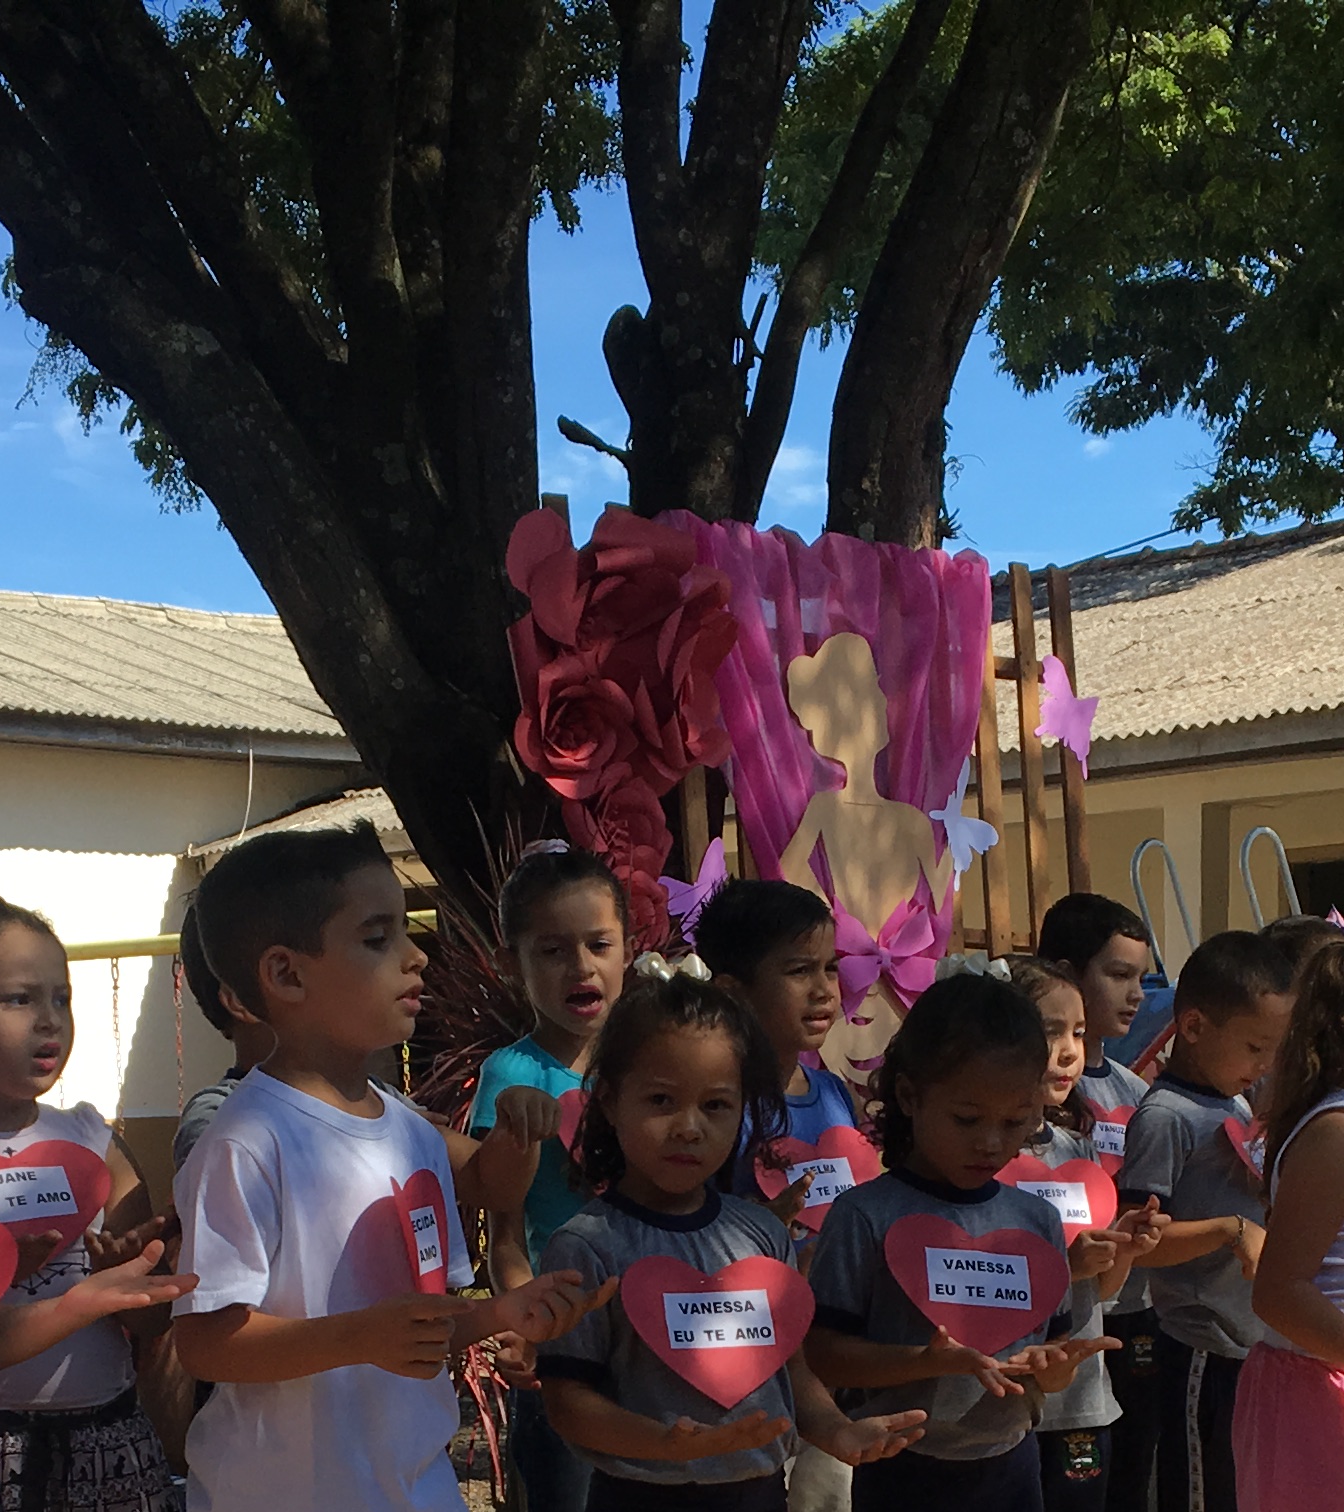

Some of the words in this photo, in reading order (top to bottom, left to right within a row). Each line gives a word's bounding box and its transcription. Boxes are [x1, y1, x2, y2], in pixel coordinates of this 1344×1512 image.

[1108, 1142, 1119, 1151] TE
[815, 1185, 831, 1197] TE
[1036, 1188, 1067, 1198] DEISY
[5, 1195, 28, 1208] TE
[36, 1191, 71, 1204] AMO
[1066, 1208, 1088, 1219] AMO
[419, 1244, 437, 1263] AMO
[943, 1258, 1016, 1275] VANESSA
[935, 1283, 956, 1296] EU
[965, 1285, 986, 1298] TE
[994, 1287, 1028, 1302] AMO
[677, 1300, 756, 1315] VANESSA
[673, 1330, 695, 1343] EU
[703, 1329, 726, 1342] TE
[735, 1326, 772, 1340] AMO
